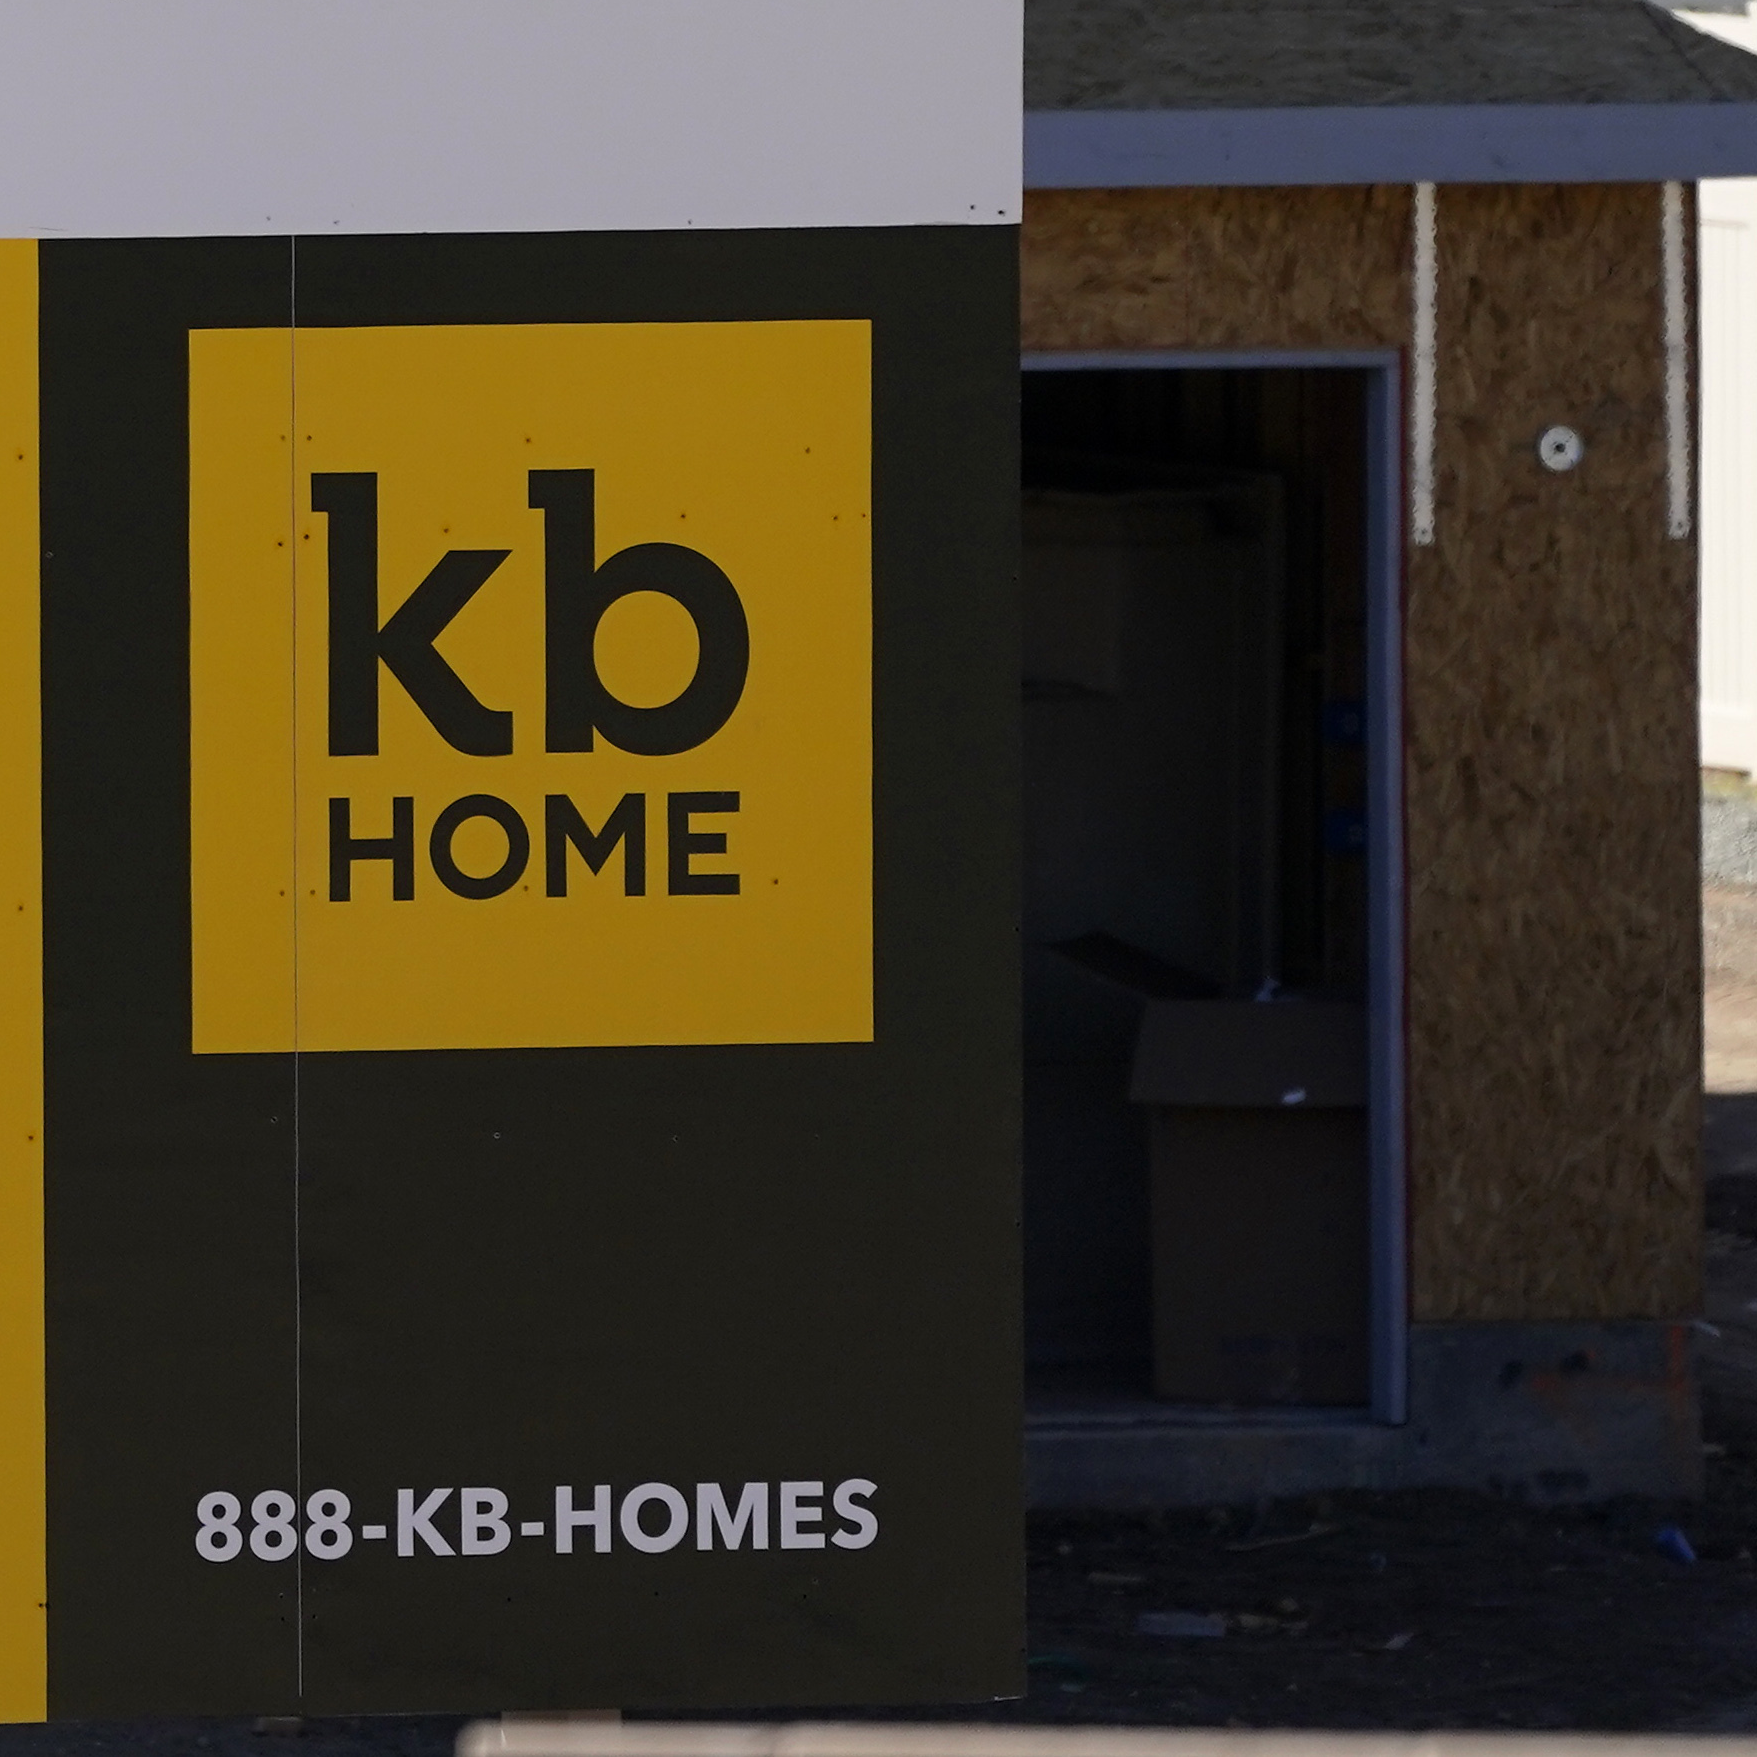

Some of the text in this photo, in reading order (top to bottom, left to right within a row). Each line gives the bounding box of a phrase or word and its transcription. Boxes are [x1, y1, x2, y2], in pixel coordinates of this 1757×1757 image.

[311, 469, 749, 756] kb
[329, 791, 740, 902] HOME
[196, 1479, 877, 1561] 888-KB-HOMES
